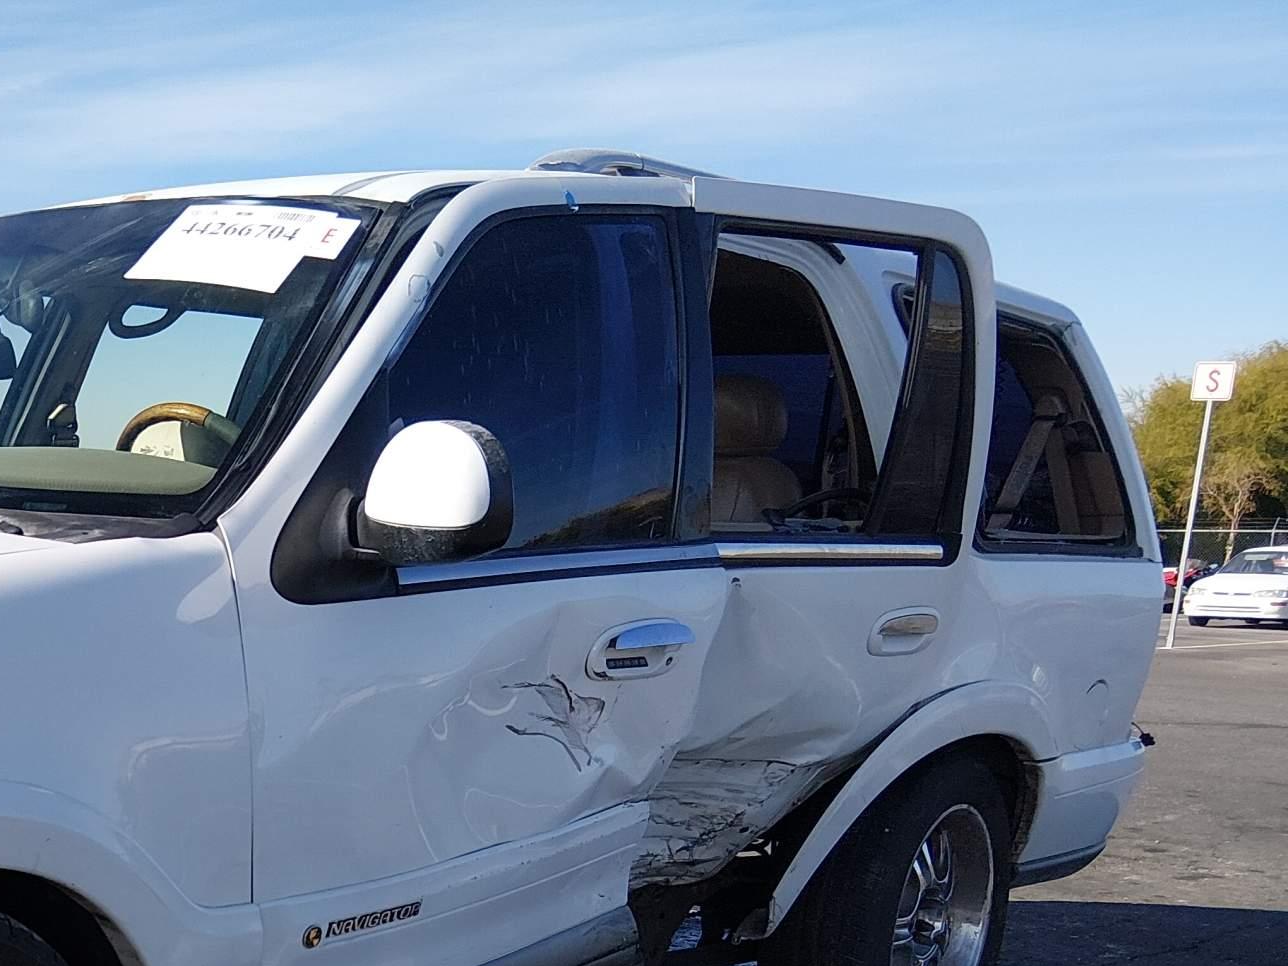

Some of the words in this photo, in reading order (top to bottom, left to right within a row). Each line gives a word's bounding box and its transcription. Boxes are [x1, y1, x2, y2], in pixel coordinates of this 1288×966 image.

[182, 221, 302, 241] 44266704
[320, 227, 338, 244] E
[1206, 368, 1221, 393] S
[326, 901, 422, 938] NAVIGATOR
